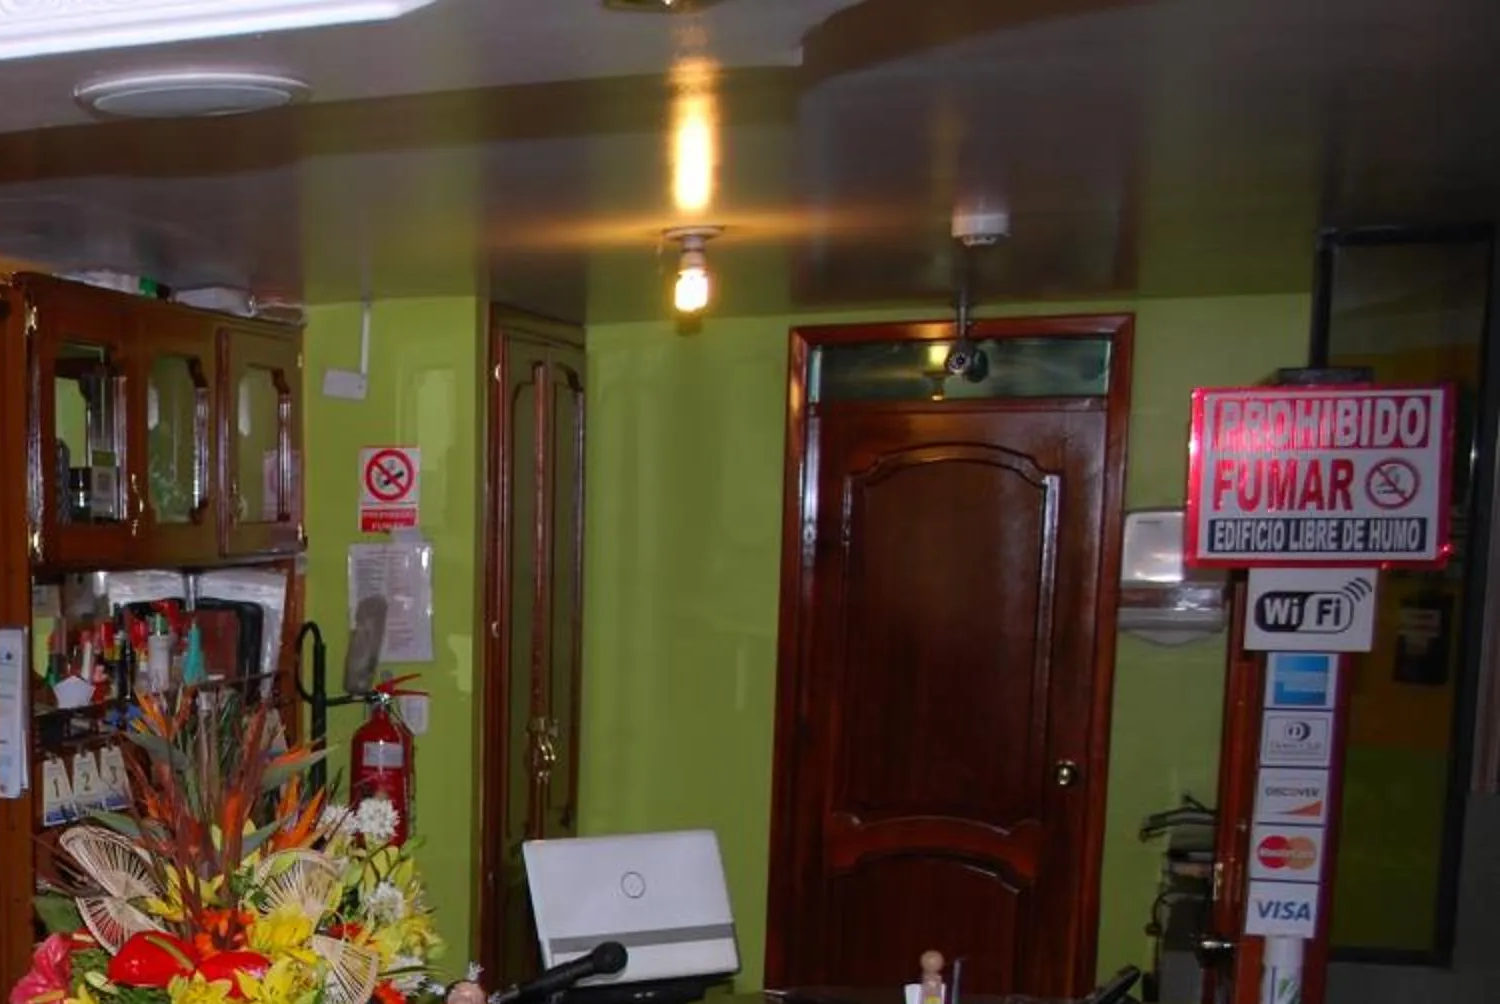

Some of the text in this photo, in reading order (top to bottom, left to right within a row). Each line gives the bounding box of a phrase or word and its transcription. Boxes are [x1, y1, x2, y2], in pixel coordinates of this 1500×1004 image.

[1222, 398, 1426, 449] PROHIBIDO
[1213, 458, 1355, 513] FUMAR
[1213, 519, 1420, 551] EDIFICIO LIBRE DE HUMO
[1257, 900, 1312, 921] VISA
